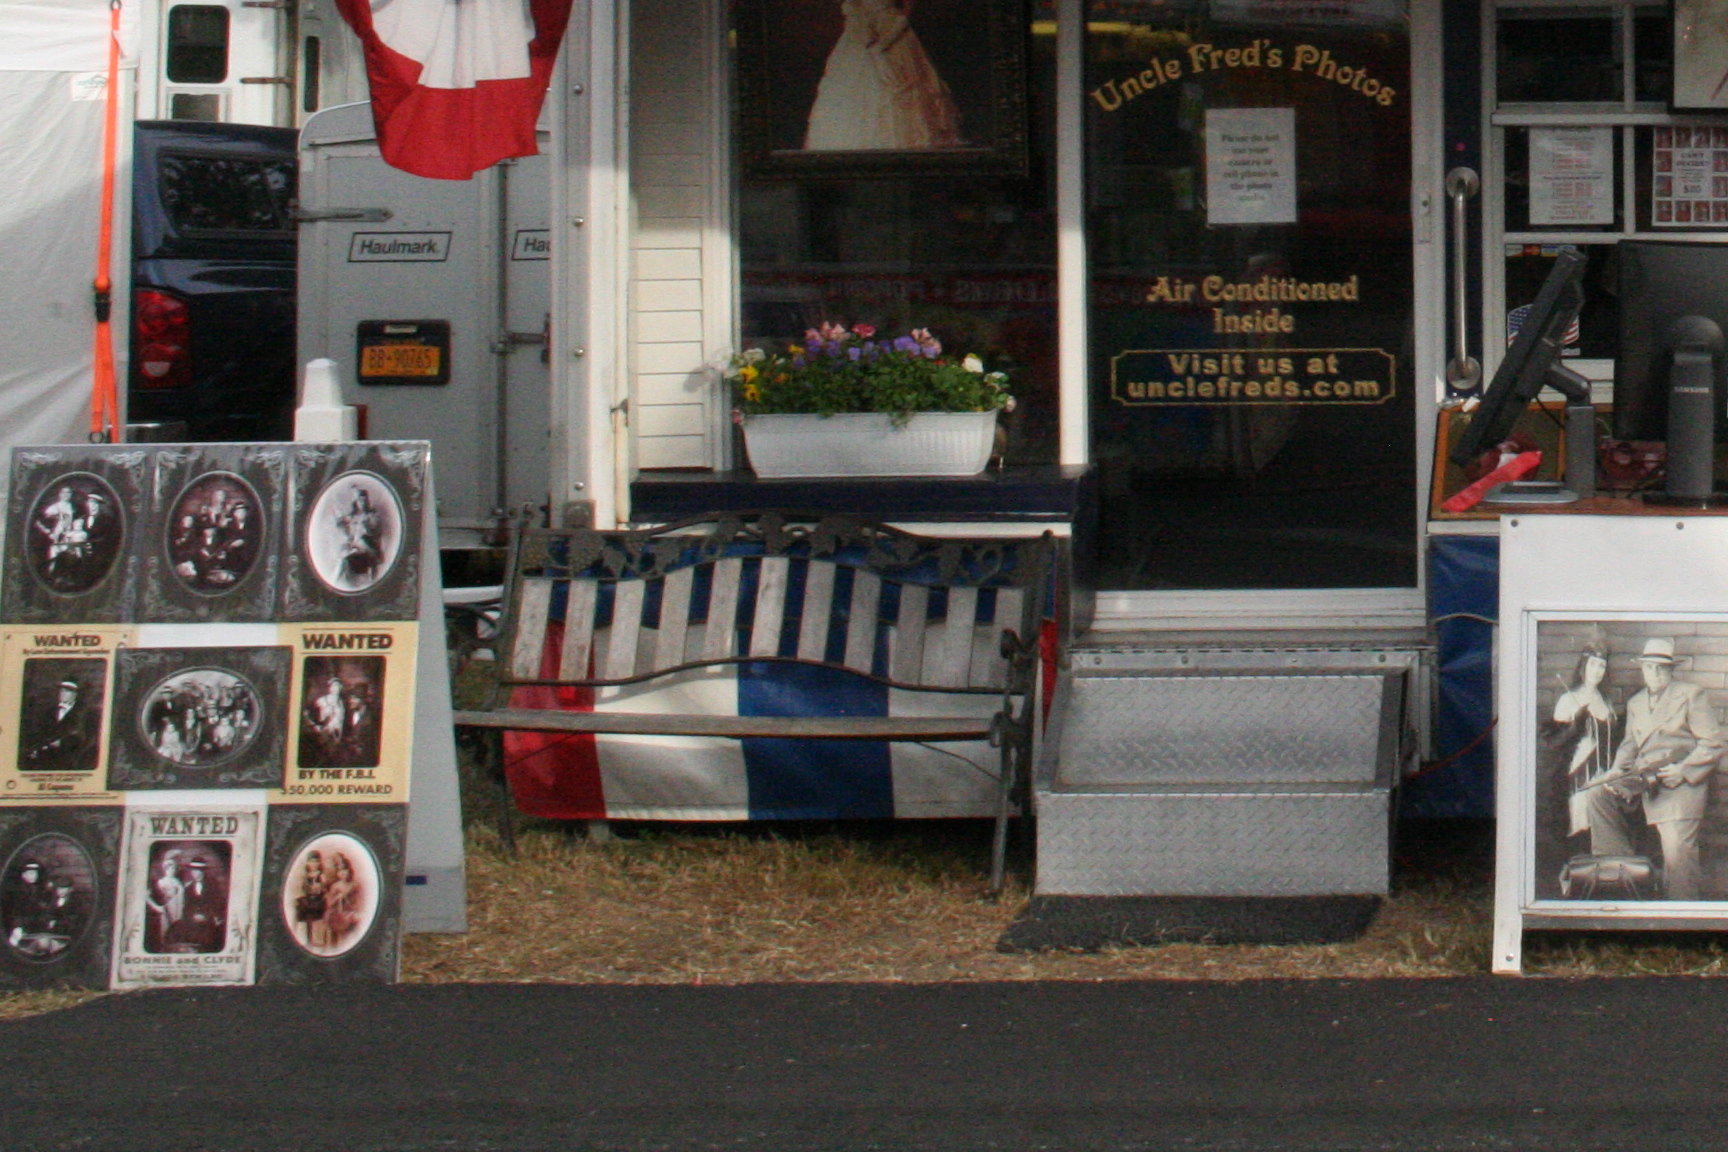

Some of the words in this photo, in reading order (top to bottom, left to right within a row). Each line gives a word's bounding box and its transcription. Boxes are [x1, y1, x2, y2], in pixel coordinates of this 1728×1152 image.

[1090, 58, 1181, 111] Uncle
[1187, 39, 1283, 73] Fred's
[1292, 44, 1396, 107] Photos
[359, 239, 438, 256] Haulmark
[1147, 276, 1196, 302] Air
[1200, 275, 1359, 301] Conditioned
[1213, 308, 1294, 333] Inside
[1168, 354, 1244, 375] Visit
[1256, 357, 1293, 375] us
[1306, 354, 1340, 375] at
[1128, 376, 1380, 397] unclefreds.com
[34, 633, 102, 647] WANTED
[302, 633, 393, 649] WANTED
[299, 769, 316, 779] BY
[319, 769, 343, 779] THE
[337, 784, 393, 795] REWARD
[150, 816, 239, 835] WANTED
[124, 955, 172, 964] BONNIE
[176, 955, 199, 964] and
[204, 955, 241, 964] CLYDE
